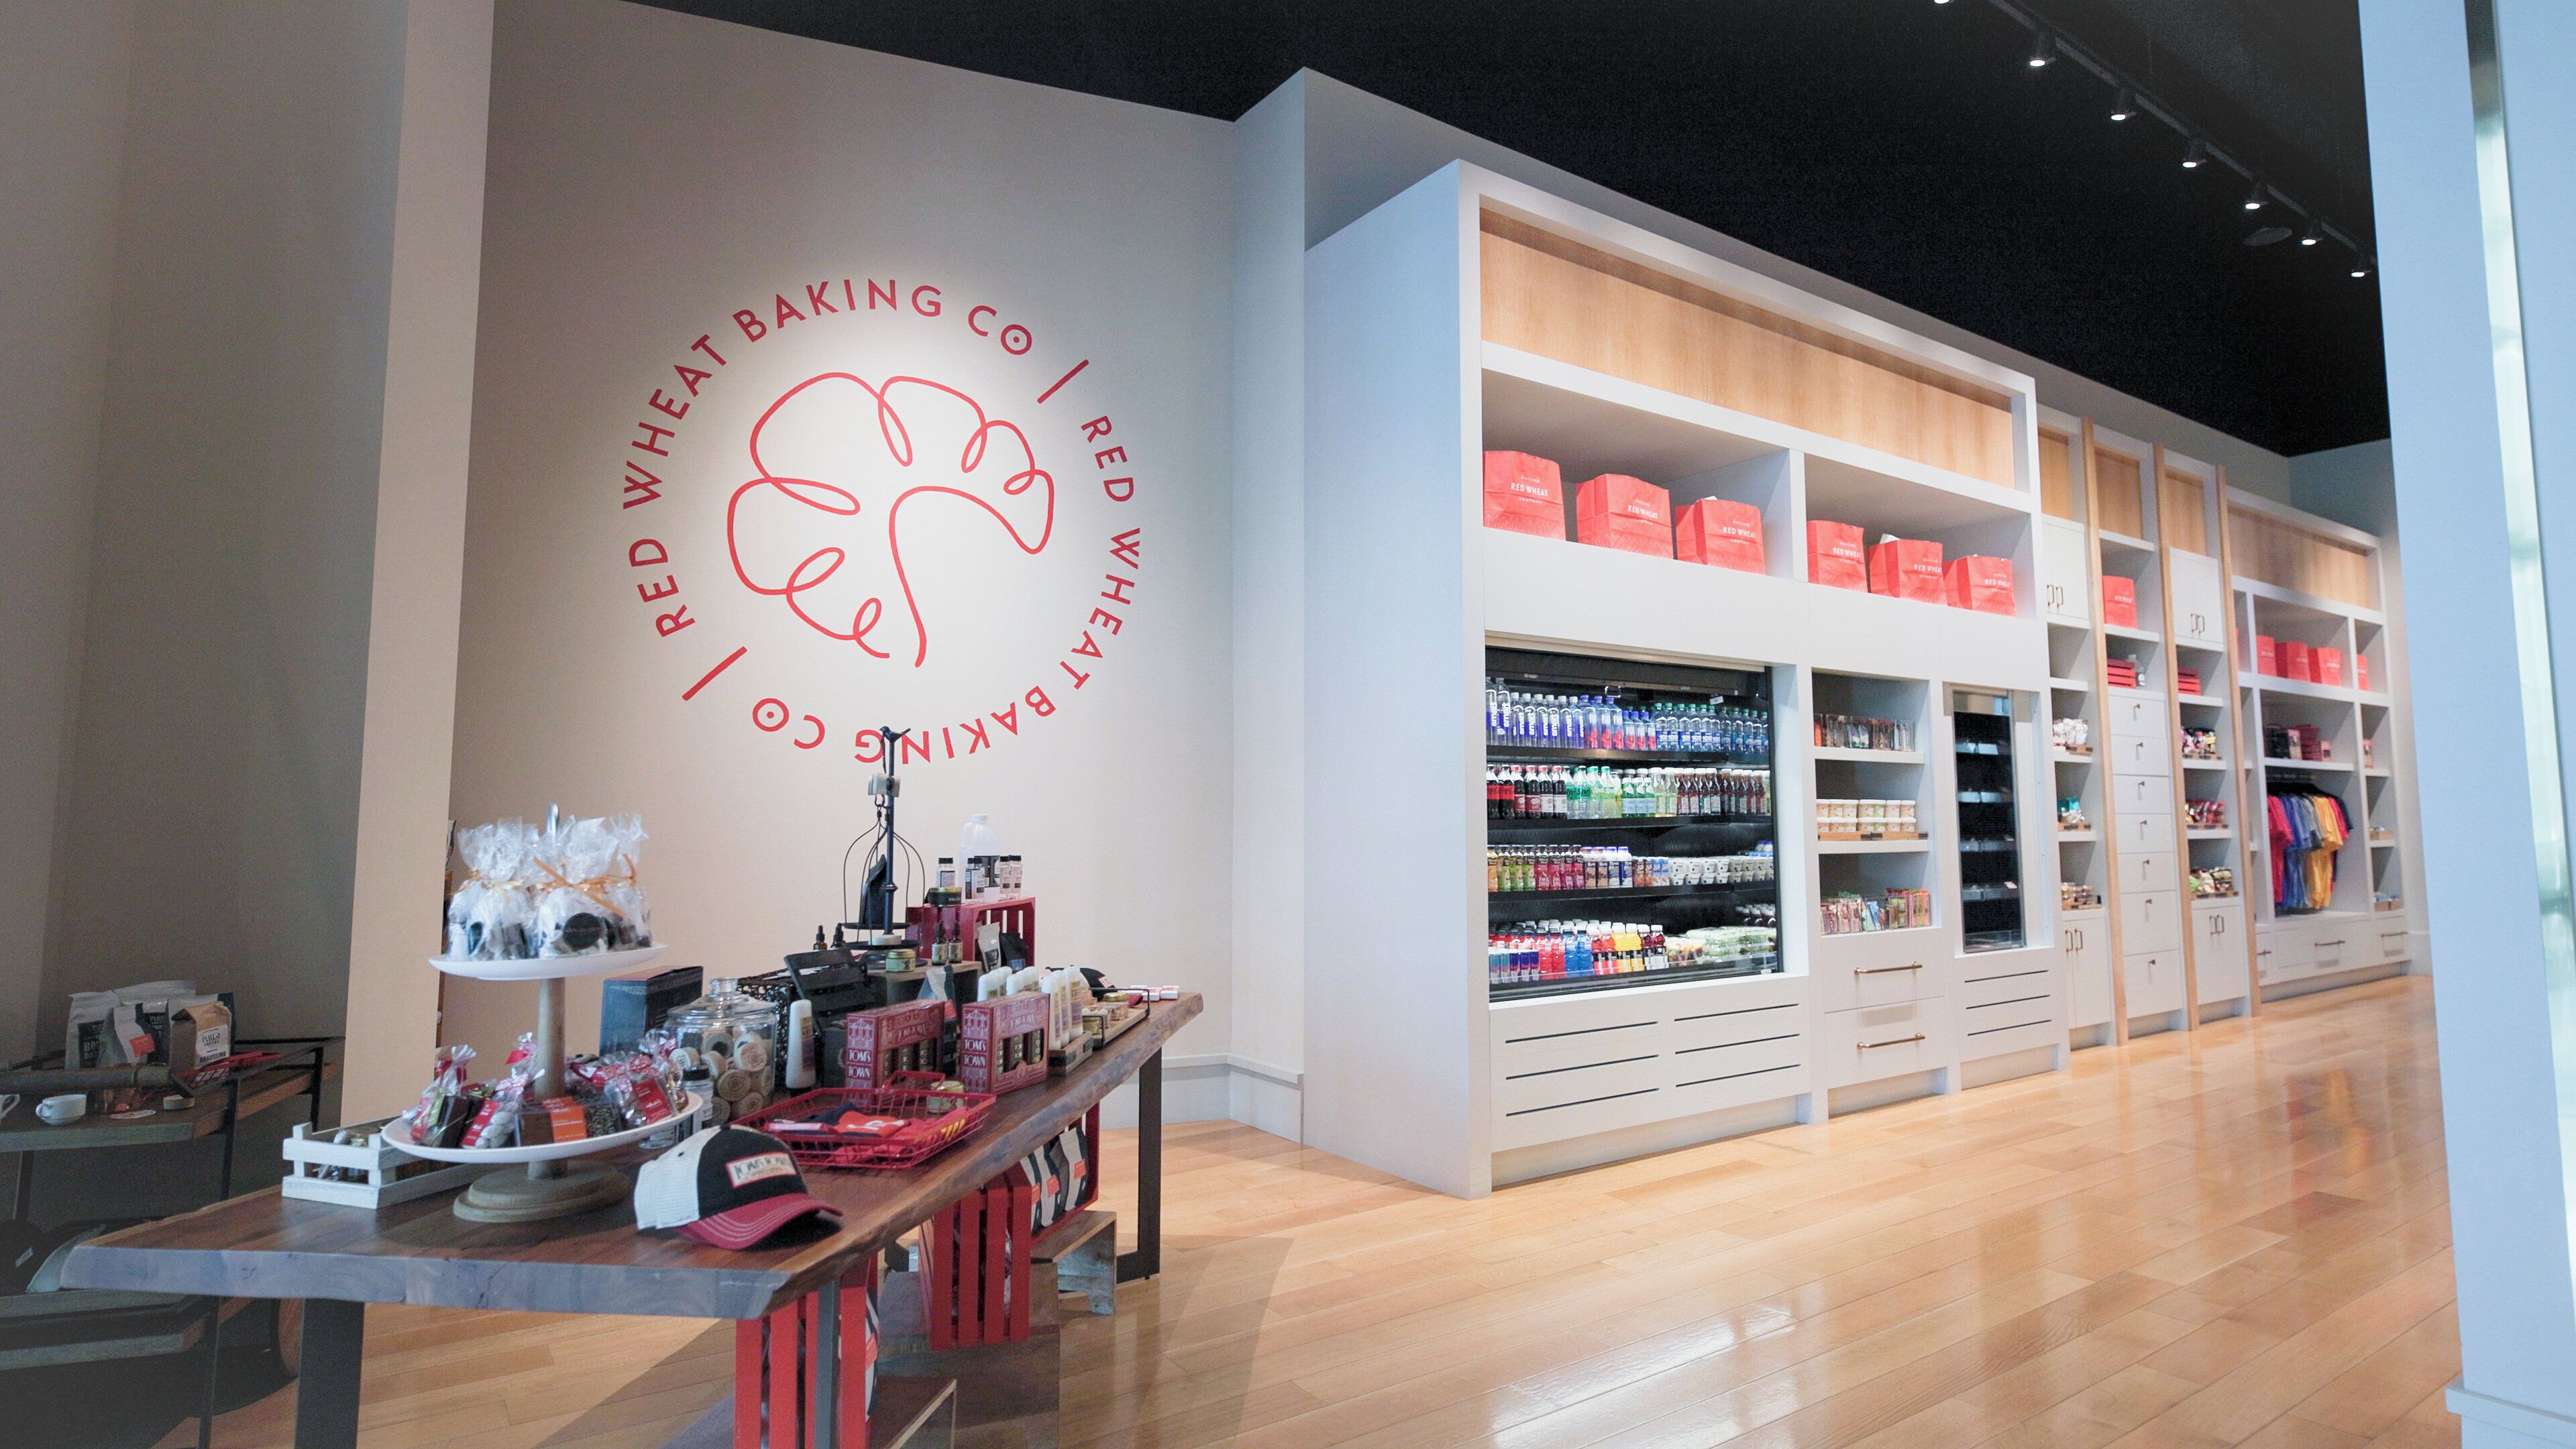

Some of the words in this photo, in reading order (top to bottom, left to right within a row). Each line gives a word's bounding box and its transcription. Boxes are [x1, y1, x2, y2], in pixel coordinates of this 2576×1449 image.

[733, 278, 942, 343] BAKING
[967, 305, 1033, 356] CO
[623, 335, 726, 509] WHEAT
[1081, 416, 1134, 502] RED
[1511, 482, 1525, 492] RED
[1525, 486, 1548, 497] WHEAT
[1627, 504, 1640, 515] RED
[1723, 526, 1736, 535] RED
[628, 538, 696, 637] RED
[1059, 528, 1140, 690] WHEAT
[751, 697, 826, 750] CO
[854, 686, 1056, 765] BAKING
[849, 1050, 871, 1063] TOM'S
[964, 1055, 986, 1066] TOWN
[965, 1039, 986, 1052] TOM'S
[848, 1066, 870, 1079] TOWN
